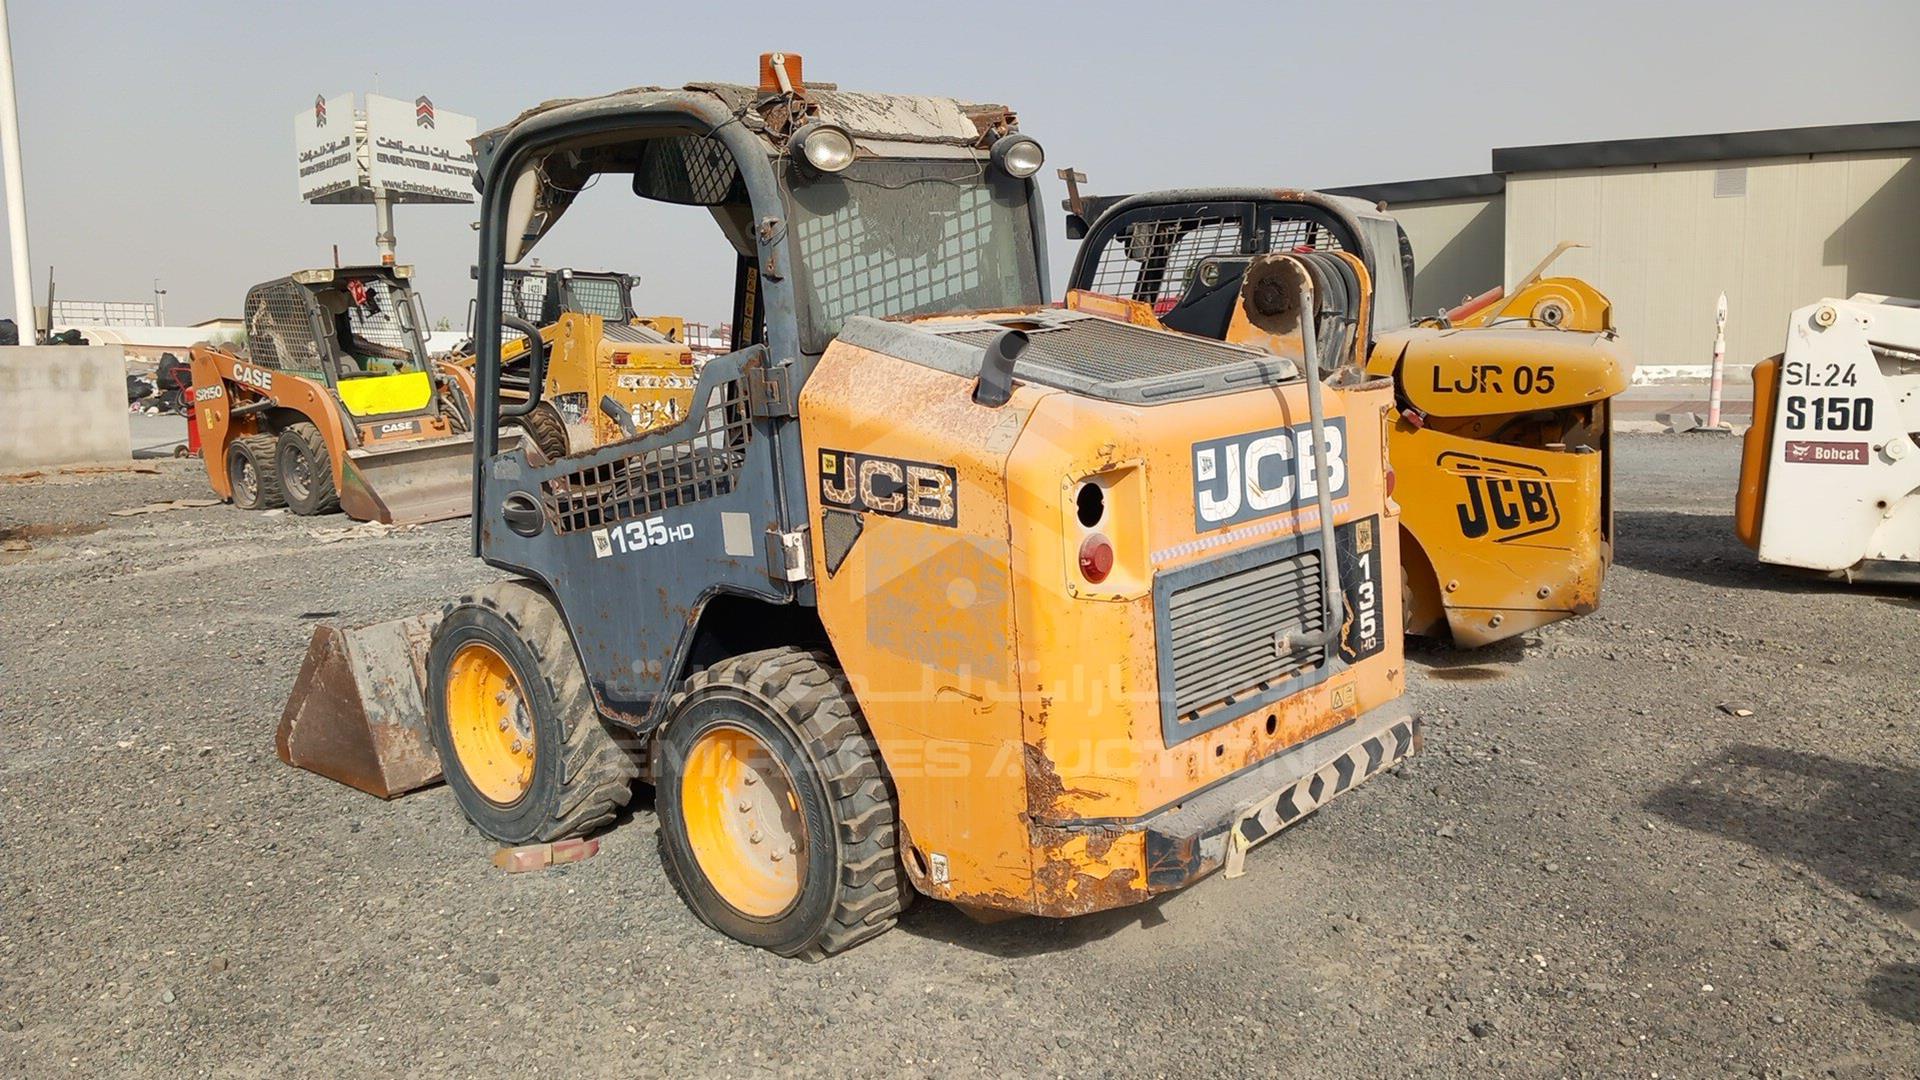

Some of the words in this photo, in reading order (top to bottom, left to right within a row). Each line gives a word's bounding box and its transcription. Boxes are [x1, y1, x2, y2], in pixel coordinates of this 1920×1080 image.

[376, 153, 431, 172] EMIRATES
[431, 162, 475, 178] AUCTION
[233, 363, 273, 391] CASE
[1432, 365, 1503, 394] LJR
[1513, 366, 1555, 395] 05
[381, 421, 413, 433] CASE
[1786, 396, 1874, 431] S150
[1815, 447, 1860, 461] Bobcat
[822, 455, 956, 521] JCB
[1197, 425, 1346, 522] JCB
[1455, 463, 1549, 539] JCB
